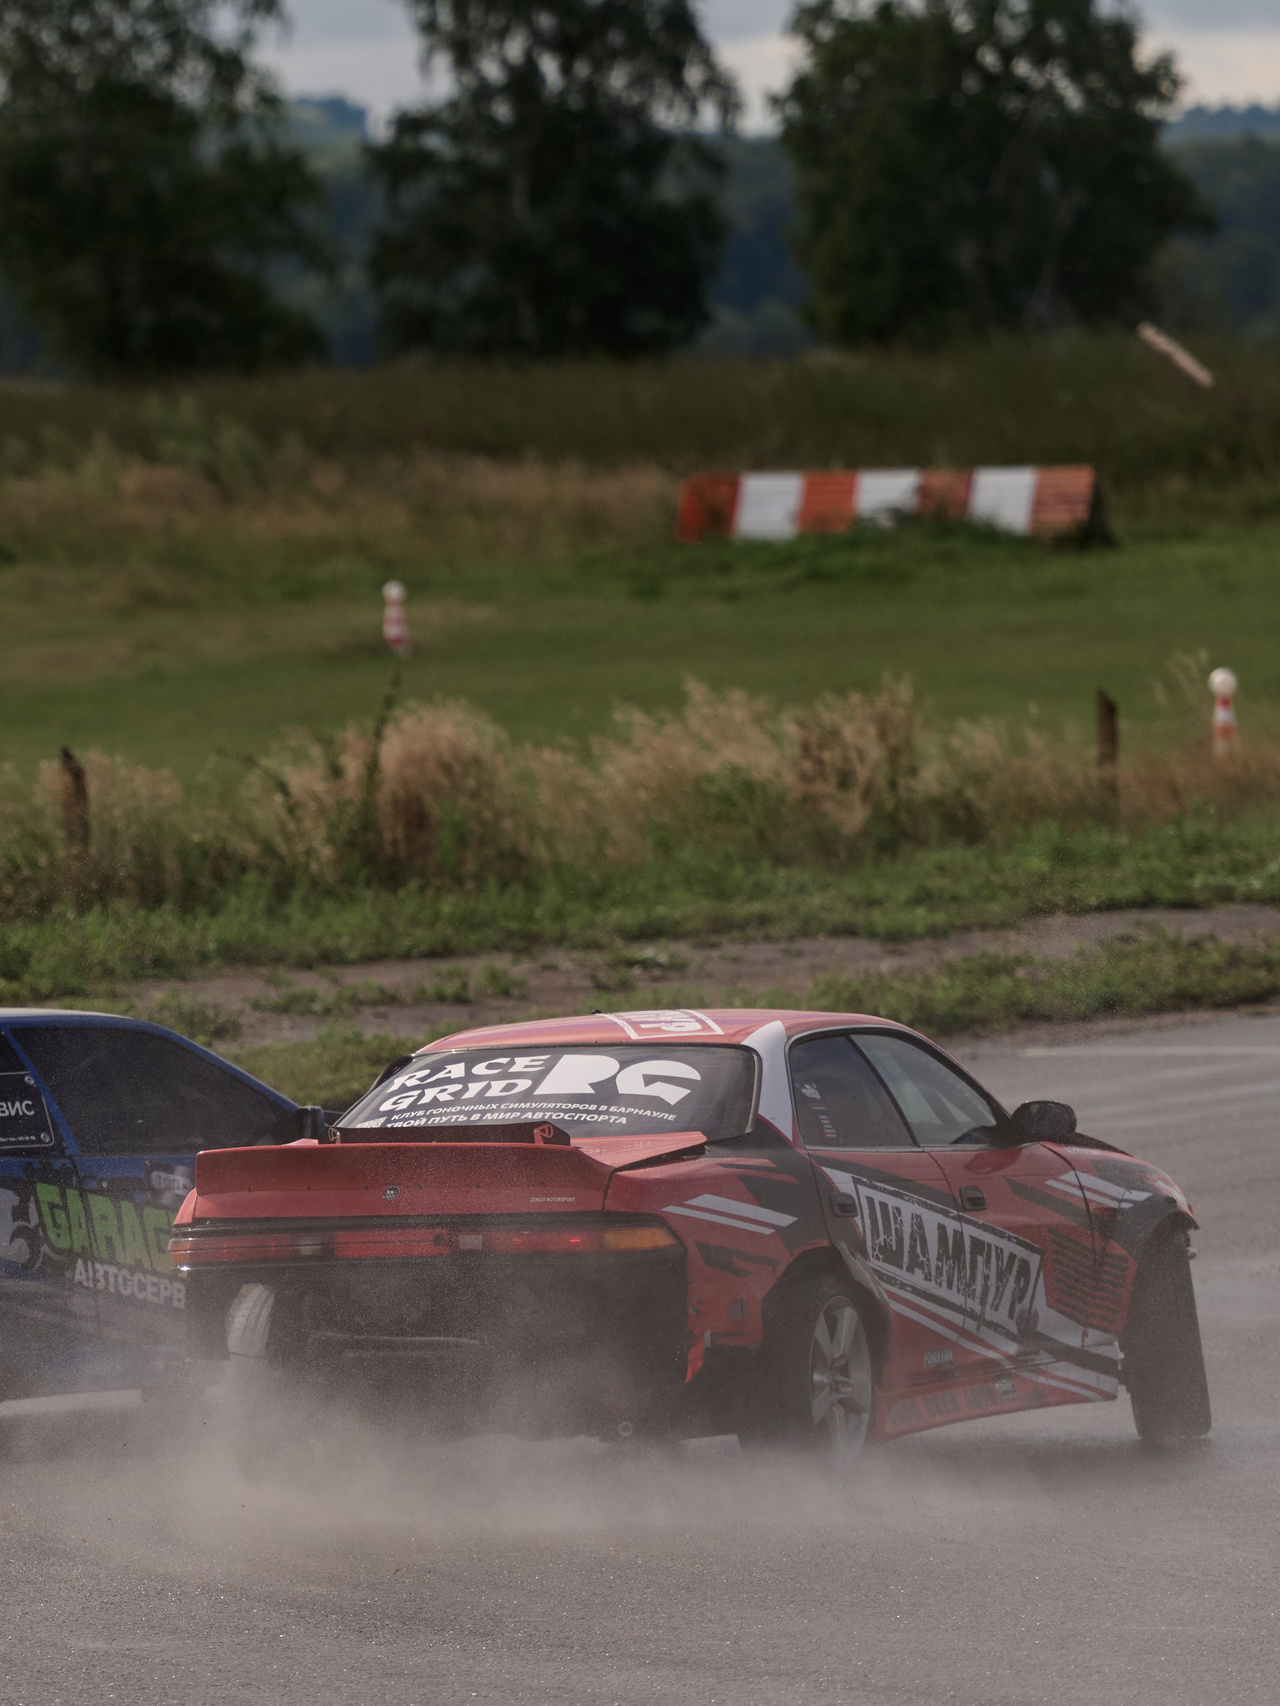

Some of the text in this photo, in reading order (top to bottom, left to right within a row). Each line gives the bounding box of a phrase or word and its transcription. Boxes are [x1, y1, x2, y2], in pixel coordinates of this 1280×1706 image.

[385, 1054, 554, 1094] RACE
[379, 1079, 533, 1112] GRID
[391, 1110, 425, 1121] КЛУБ
[426, 1103, 499, 1116] ГОНОЧНЫХ
[499, 1102, 598, 1111] СИМУЛЯТОРОВ
[608, 1105, 677, 1121] БАРНАУЛЕ
[386, 1112, 627, 1128] ТВОЙ ПУТЬ В МИР АВТОСПОРТА
[865, 1195, 1032, 1320] ШАМПУР
